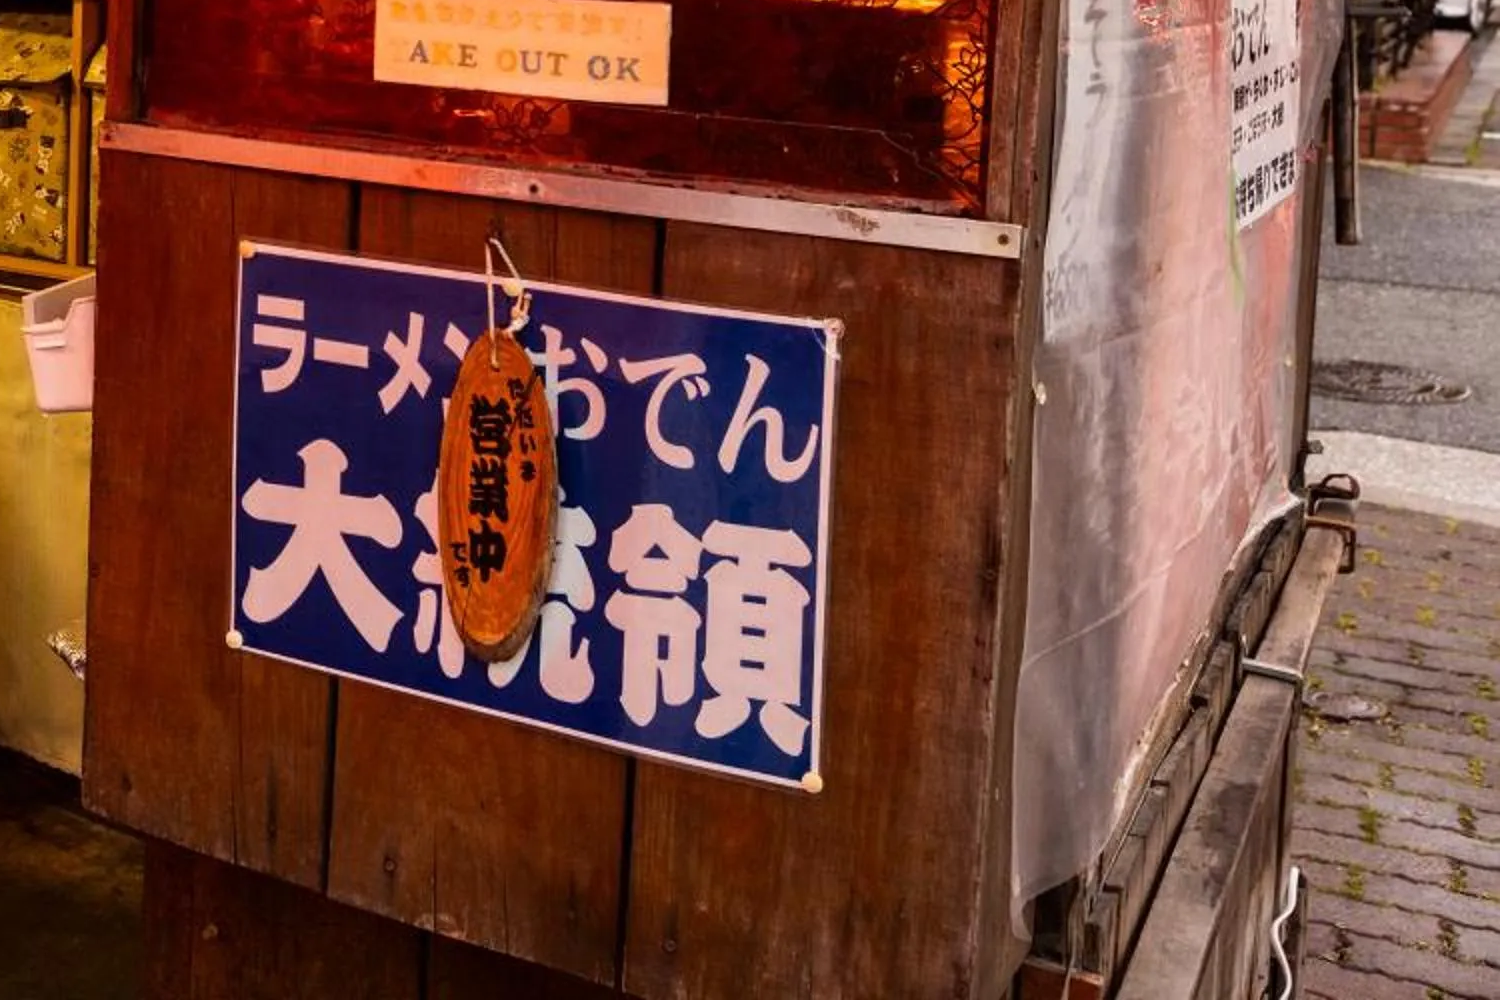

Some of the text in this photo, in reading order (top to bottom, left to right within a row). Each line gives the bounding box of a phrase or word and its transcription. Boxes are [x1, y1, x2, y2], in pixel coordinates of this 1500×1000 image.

[390, 37, 643, 82] AKE OUT OK
[525, 322, 819, 483] おでん
[468, 392, 513, 584] 営業中
[451, 541, 470, 588] です
